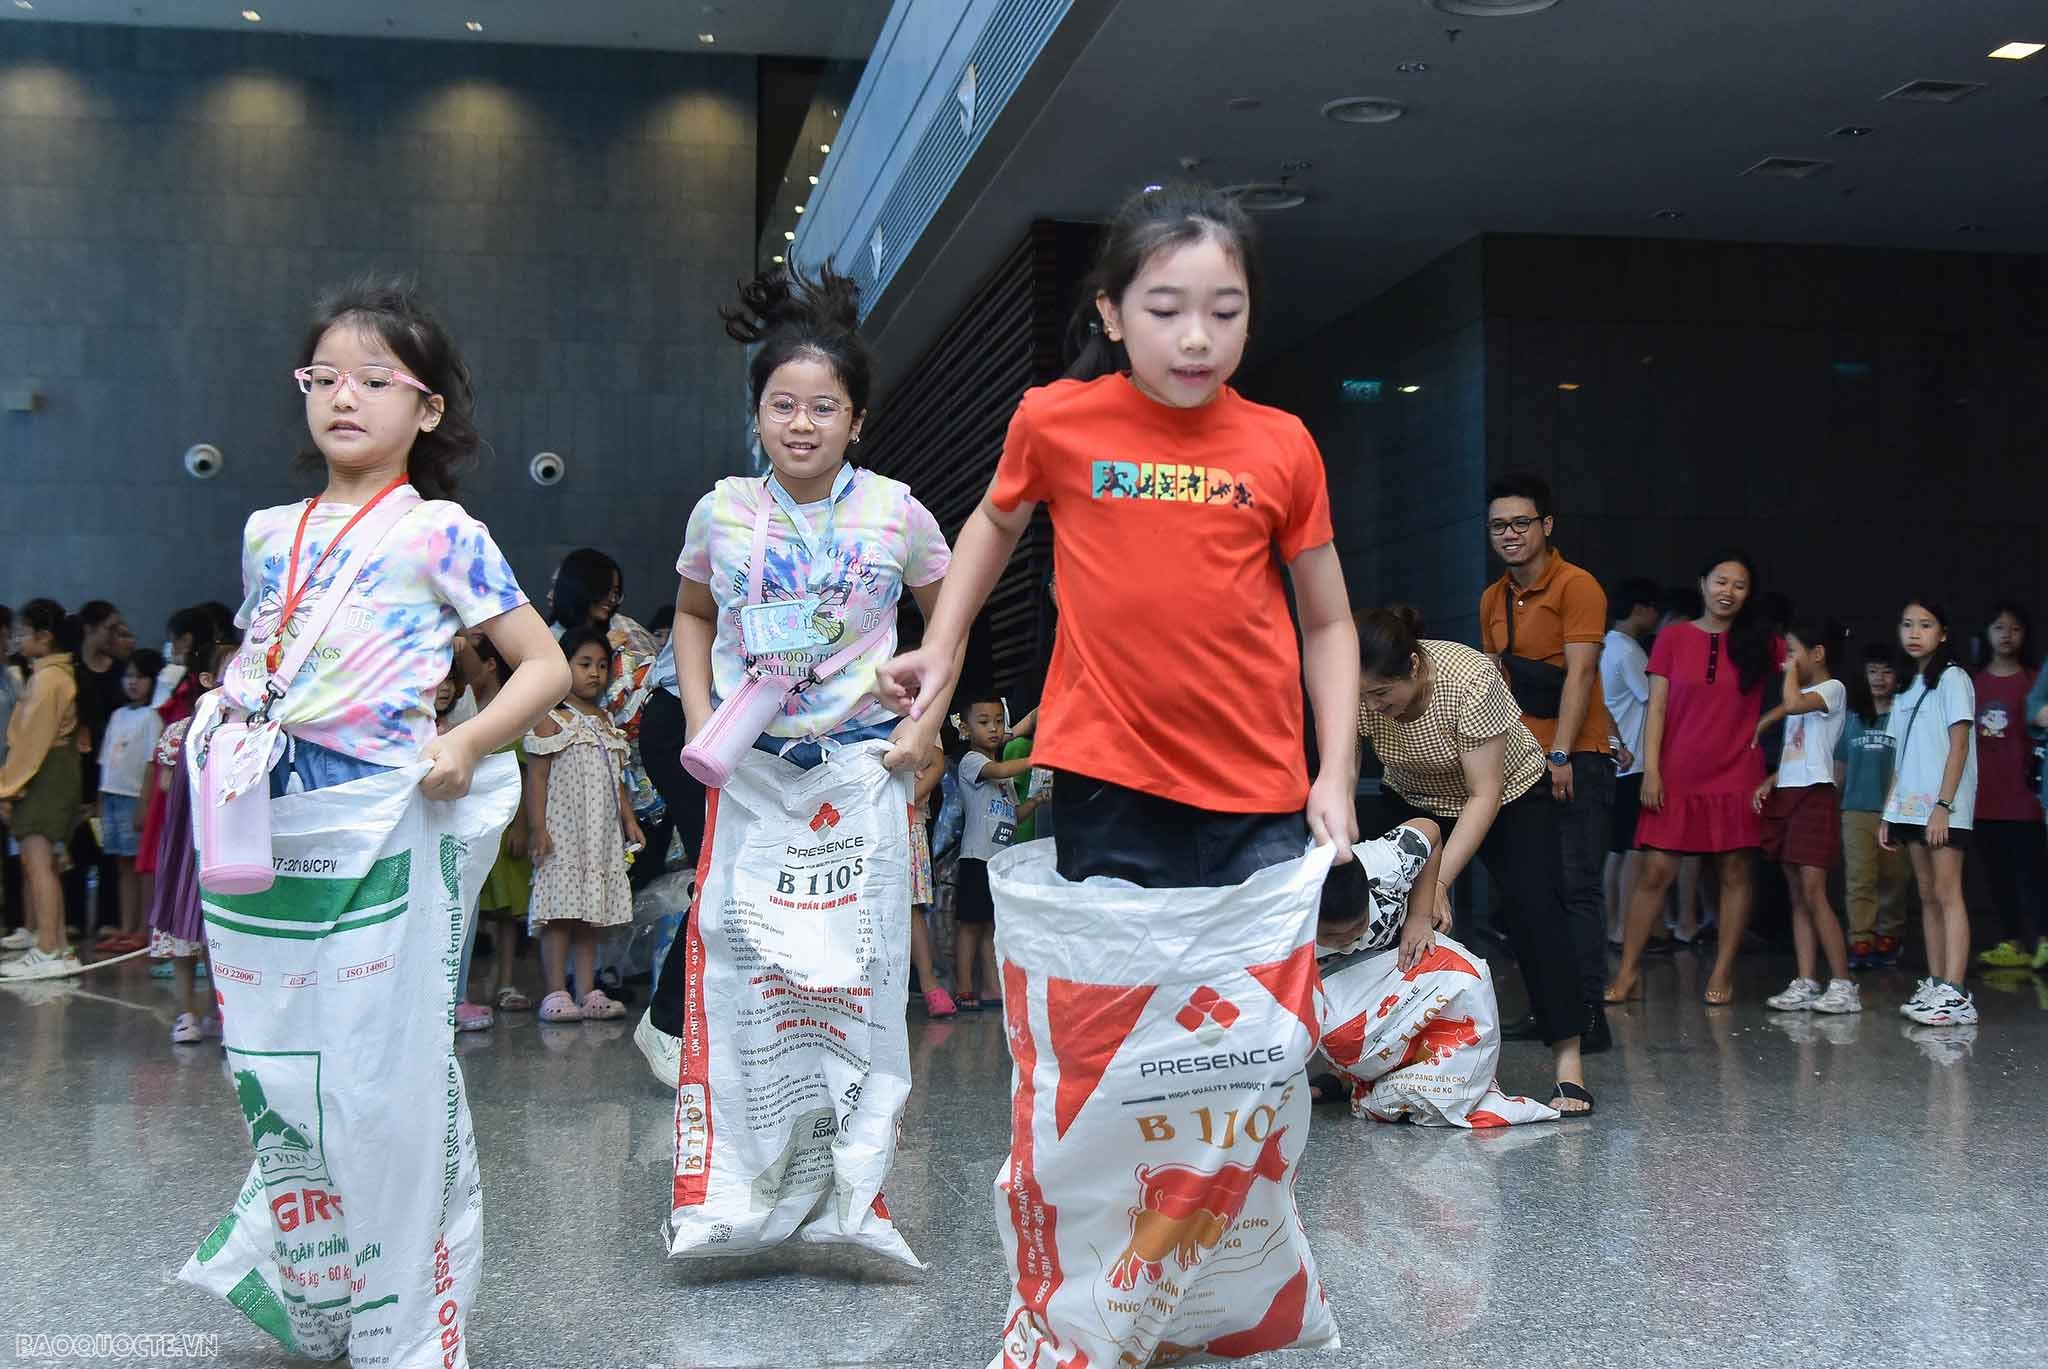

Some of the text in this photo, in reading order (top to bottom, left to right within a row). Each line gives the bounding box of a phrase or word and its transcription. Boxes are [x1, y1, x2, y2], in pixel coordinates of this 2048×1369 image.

[1091, 459, 1257, 509] FRIENDS
[826, 546, 880, 598] OURSELF
[777, 651, 814, 664] GOOD
[764, 664, 795, 677] WILL
[786, 836, 865, 858] PRESENCE
[776, 870, 796, 895] B
[346, 960, 388, 979] ISO 14001
[1140, 1044, 1286, 1077] PRESENCE
[1191, 1083, 1227, 1096] QUALITY
[1229, 1080, 1265, 1092] PRODUCT
[1452, 1076, 1466, 1084] CHO
[843, 1081, 863, 1102] 25
[1135, 1114, 1176, 1142] B
[685, 1154, 703, 1170] B
[271, 1187, 345, 1233] GR
[1242, 1217, 1269, 1230] CHO
[317, 1233, 351, 1258] CHỈN
[1224, 1238, 1242, 1249] KG
[343, 1263, 352, 1280] k
[1034, 1279, 1051, 1303] CHO
